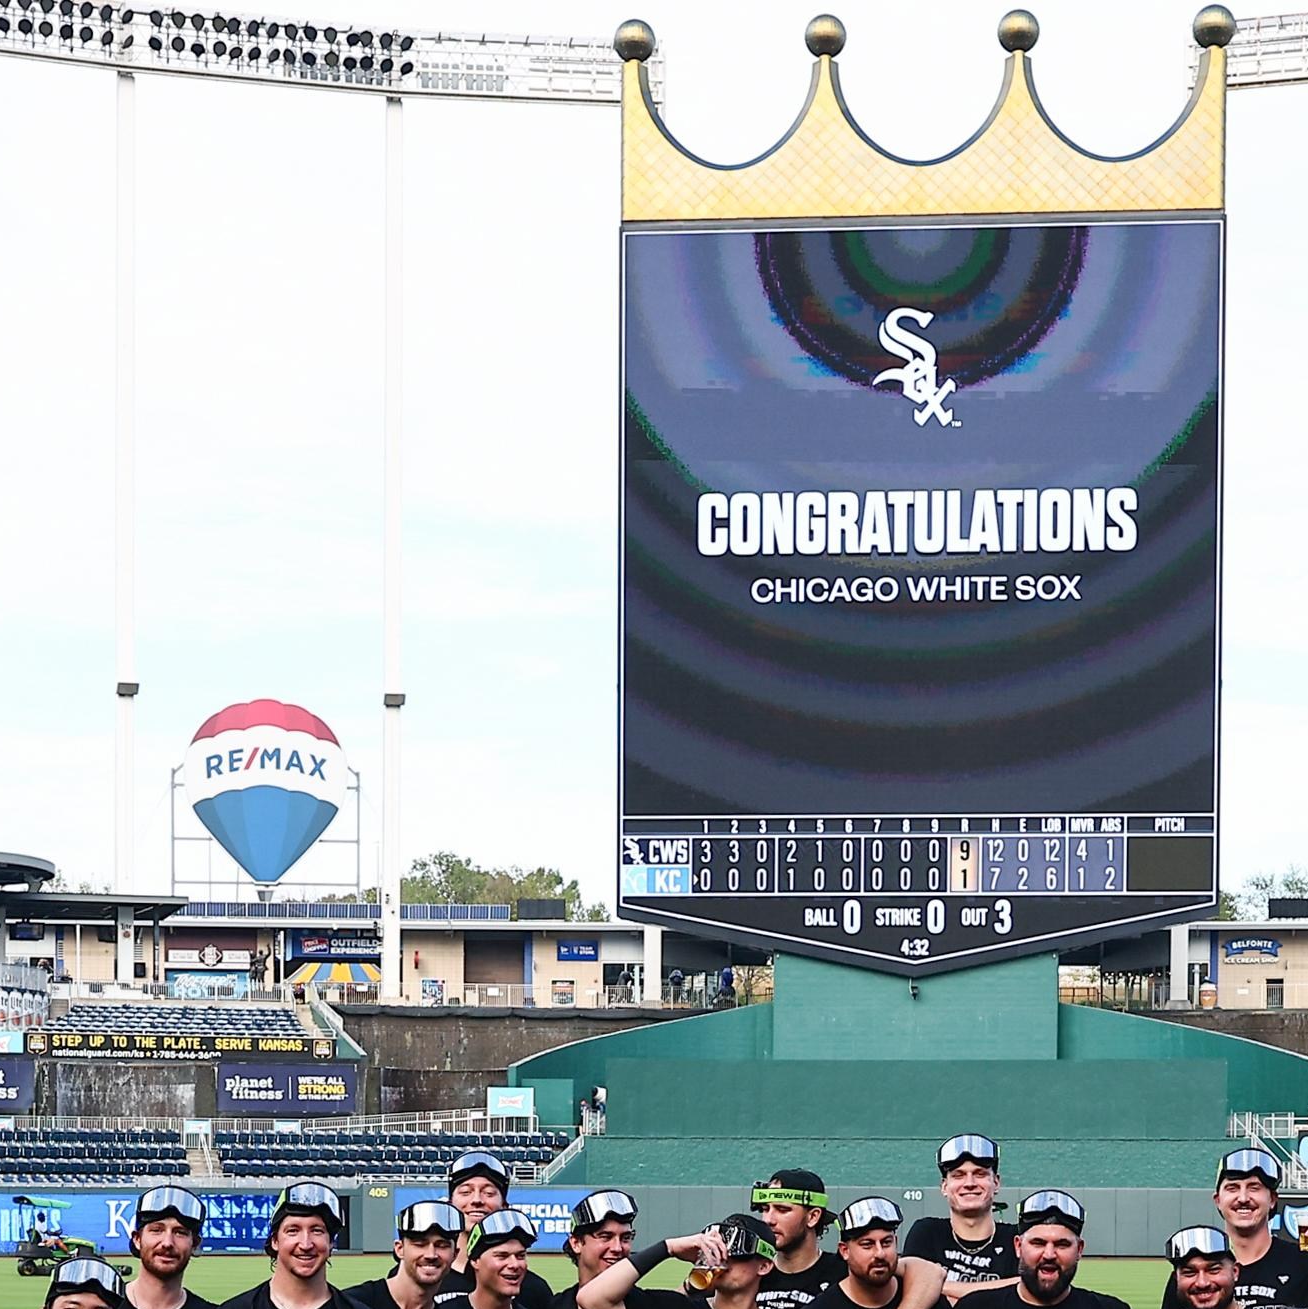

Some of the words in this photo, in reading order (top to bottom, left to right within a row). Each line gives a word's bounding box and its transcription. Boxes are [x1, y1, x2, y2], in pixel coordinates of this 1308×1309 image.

[697, 487, 1138, 556] CONGRATULATIONS
[751, 576, 899, 604] CHICAGO
[907, 575, 1009, 602] WHITE
[1014, 574, 1082, 602] SOX
[206, 747, 327, 780] RE/MAX
[961, 819, 969, 832] R
[992, 819, 999, 832] H
[1019, 818, 1026, 832] E
[1042, 818, 1062, 832] LOB
[1071, 818, 1094, 832] MVR
[1101, 817, 1121, 831] ABS
[1154, 818, 1184, 832] PITCH
[648, 839, 688, 863] CWS
[701, 840, 711, 863] 3
[729, 840, 739, 863] 3
[757, 840, 767, 863] 0
[786, 840, 797, 862] 2
[816, 840, 823, 862] 1
[842, 840, 853, 862] 0
[872, 839, 883, 862] 0
[900, 839, 911, 862] 0
[929, 839, 939, 862] 0
[960, 840, 970, 861] 9
[987, 839, 1003, 862] 12
[1018, 839, 1028, 862] 0
[1044, 839, 1060, 862] 12
[1077, 839, 1088, 861] 4
[1107, 839, 1113, 861] 1
[654, 868, 681, 892] KC
[700, 868, 711, 891] 0
[728, 868, 739, 891] 0
[756, 868, 767, 891] 0
[787, 868, 794, 890] 1
[814, 868, 825, 890] 0
[842, 868, 853, 890] 0
[872, 868, 883, 890] 0
[900, 868, 911, 890] 0
[928, 868, 939, 890] 0
[961, 869, 967, 889] 1
[990, 868, 1000, 890] 7
[1018, 868, 1028, 890] 2
[1046, 868, 1057, 890] 6
[1078, 867, 1084, 889] 1
[1105, 867, 1115, 889] 2
[805, 908, 837, 927] BALL
[843, 899, 861, 934] 0
[875, 908, 921, 927] STRIKE
[926, 899, 945, 934] 0
[961, 908, 987, 926] OUT
[993, 899, 1012, 934] 3
[900, 939, 929, 956] 4:32
[1232, 940, 1273, 949] BELFONTE
[52, 1034, 83, 1047] STEP
[89, 1035, 105, 1047] UP
[111, 1036, 127, 1048] TO
[134, 1037, 157, 1048] THE
[163, 1037, 206, 1049] PLATE.
[215, 1038, 252, 1050] SERVE
[259, 1039, 308, 1051] KANSAS.
[52, 1050, 144, 1059] nationalguard.com/ks
[369, 1188, 388, 1198] 405
[903, 1190, 922, 1200] 410
